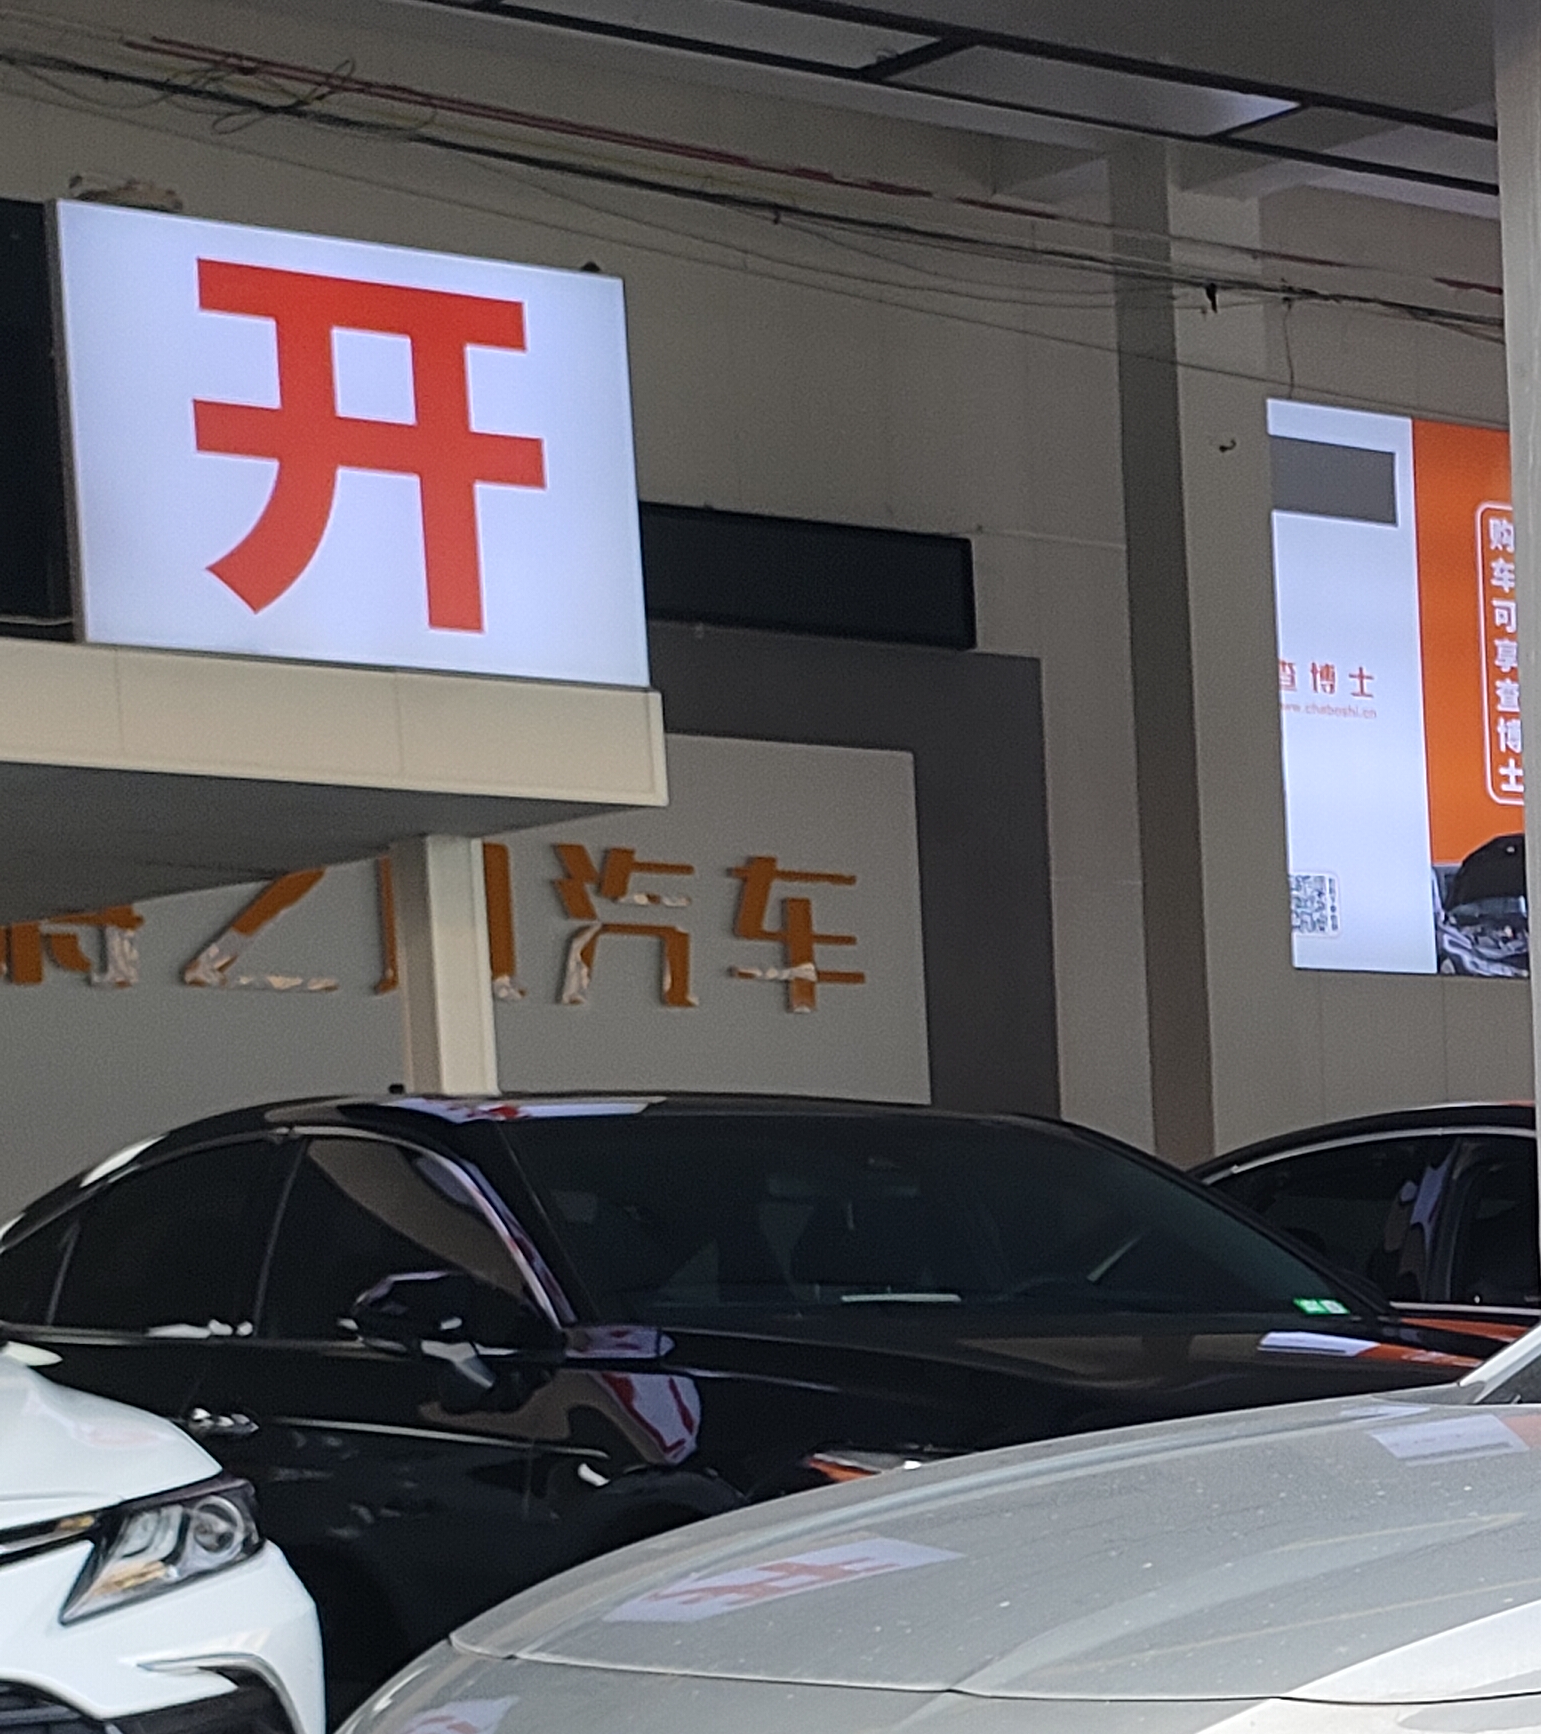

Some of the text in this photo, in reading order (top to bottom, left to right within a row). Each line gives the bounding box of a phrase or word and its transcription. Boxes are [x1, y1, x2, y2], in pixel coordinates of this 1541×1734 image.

[193, 257, 547, 635] 开
[1488, 517, 1525, 793] 购车可享查博士
